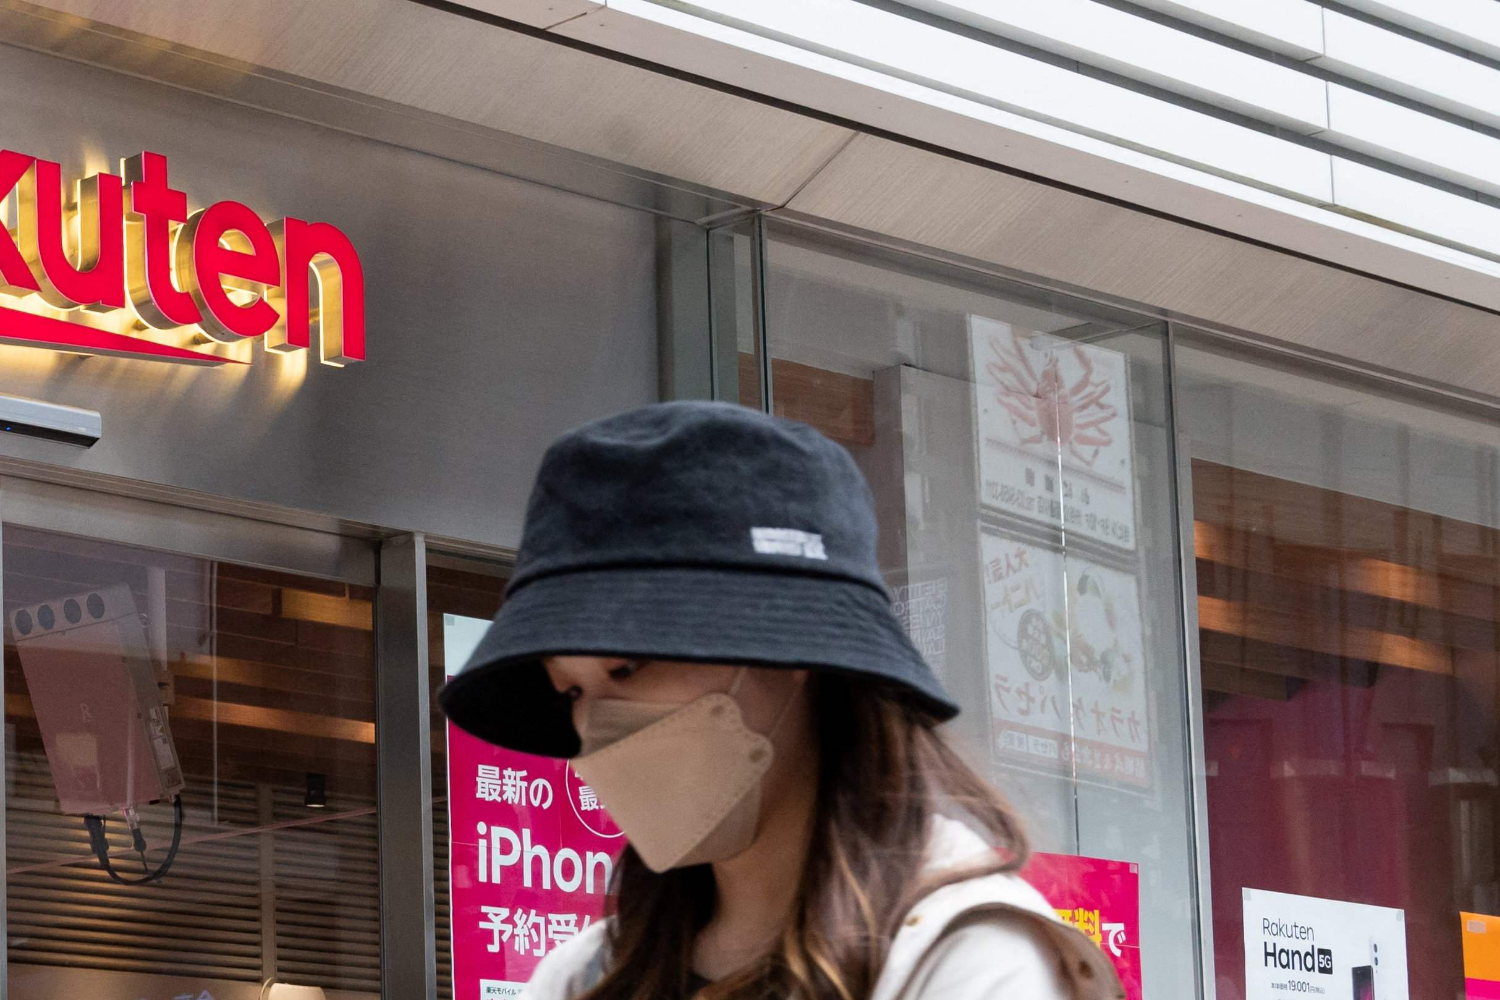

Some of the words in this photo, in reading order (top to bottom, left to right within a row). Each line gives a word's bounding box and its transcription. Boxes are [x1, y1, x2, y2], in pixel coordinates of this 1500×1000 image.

[475, 763, 553, 809] 最新の
[578, 785, 606, 811] 最
[477, 821, 613, 895] iPhon
[478, 904, 592, 957] 予約受
[1262, 917, 1315, 941] Rakuten
[1263, 941, 1316, 973] Hand
[1319, 954, 1332, 969] 5G
